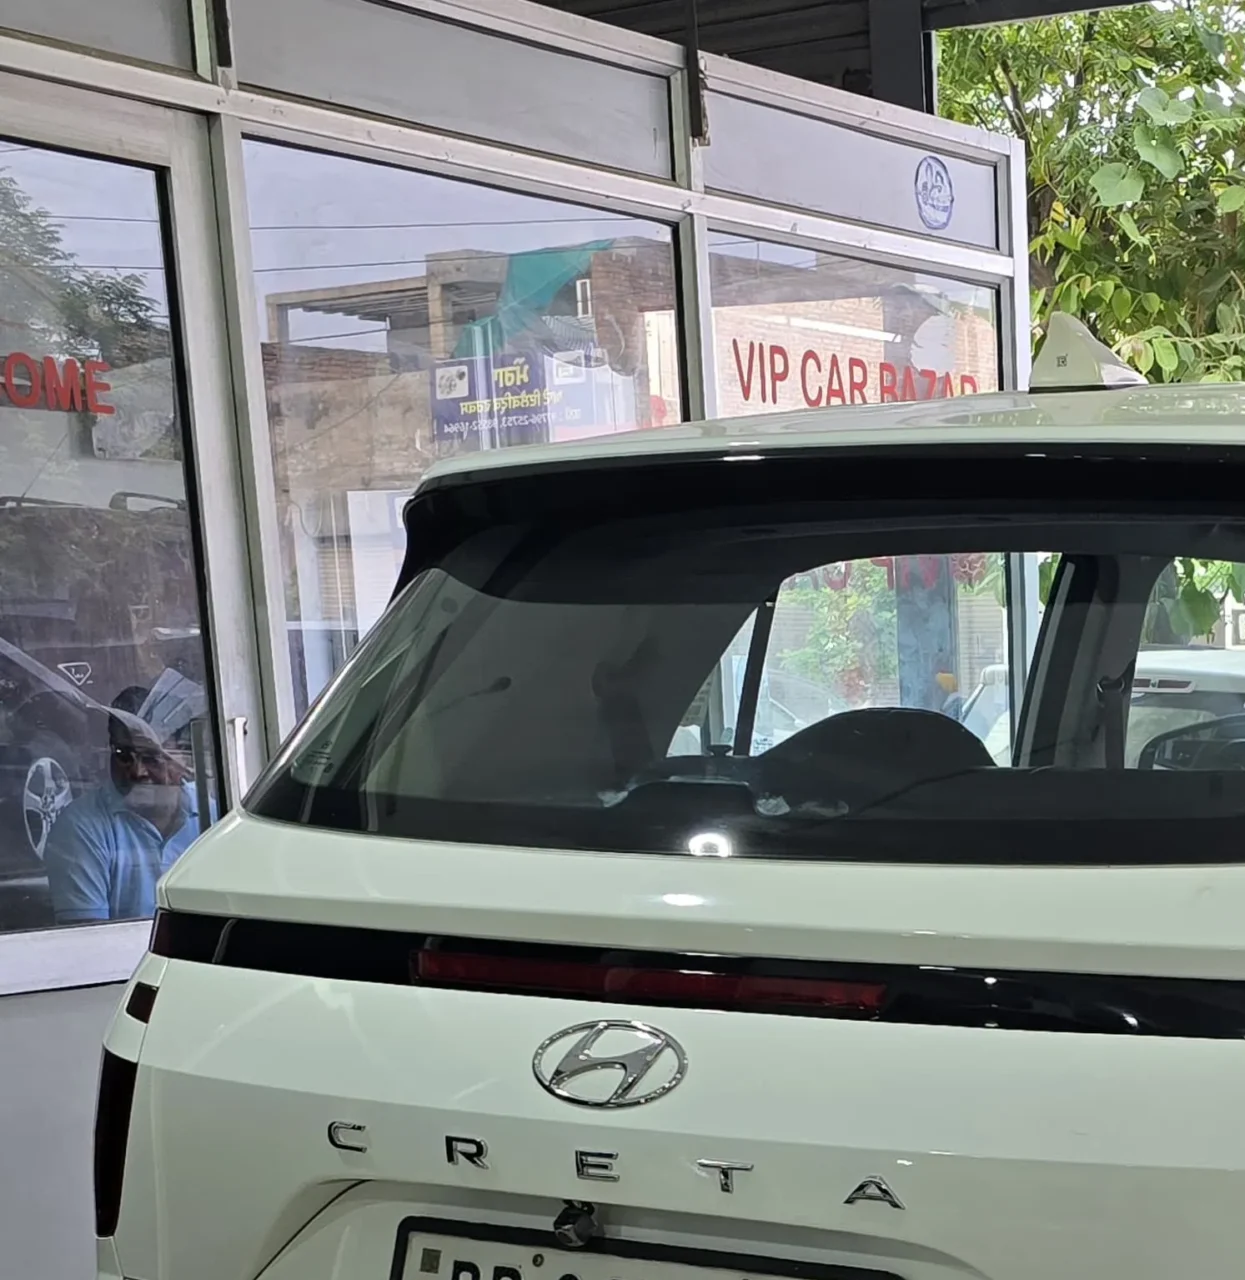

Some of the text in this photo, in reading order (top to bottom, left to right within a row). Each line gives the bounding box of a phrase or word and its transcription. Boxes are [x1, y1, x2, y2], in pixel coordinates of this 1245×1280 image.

[0, 351, 116, 415] OME
[732, 338, 789, 404] VIP
[800, 349, 868, 408] CAR
[327, 1119, 906, 1210] CRETA
